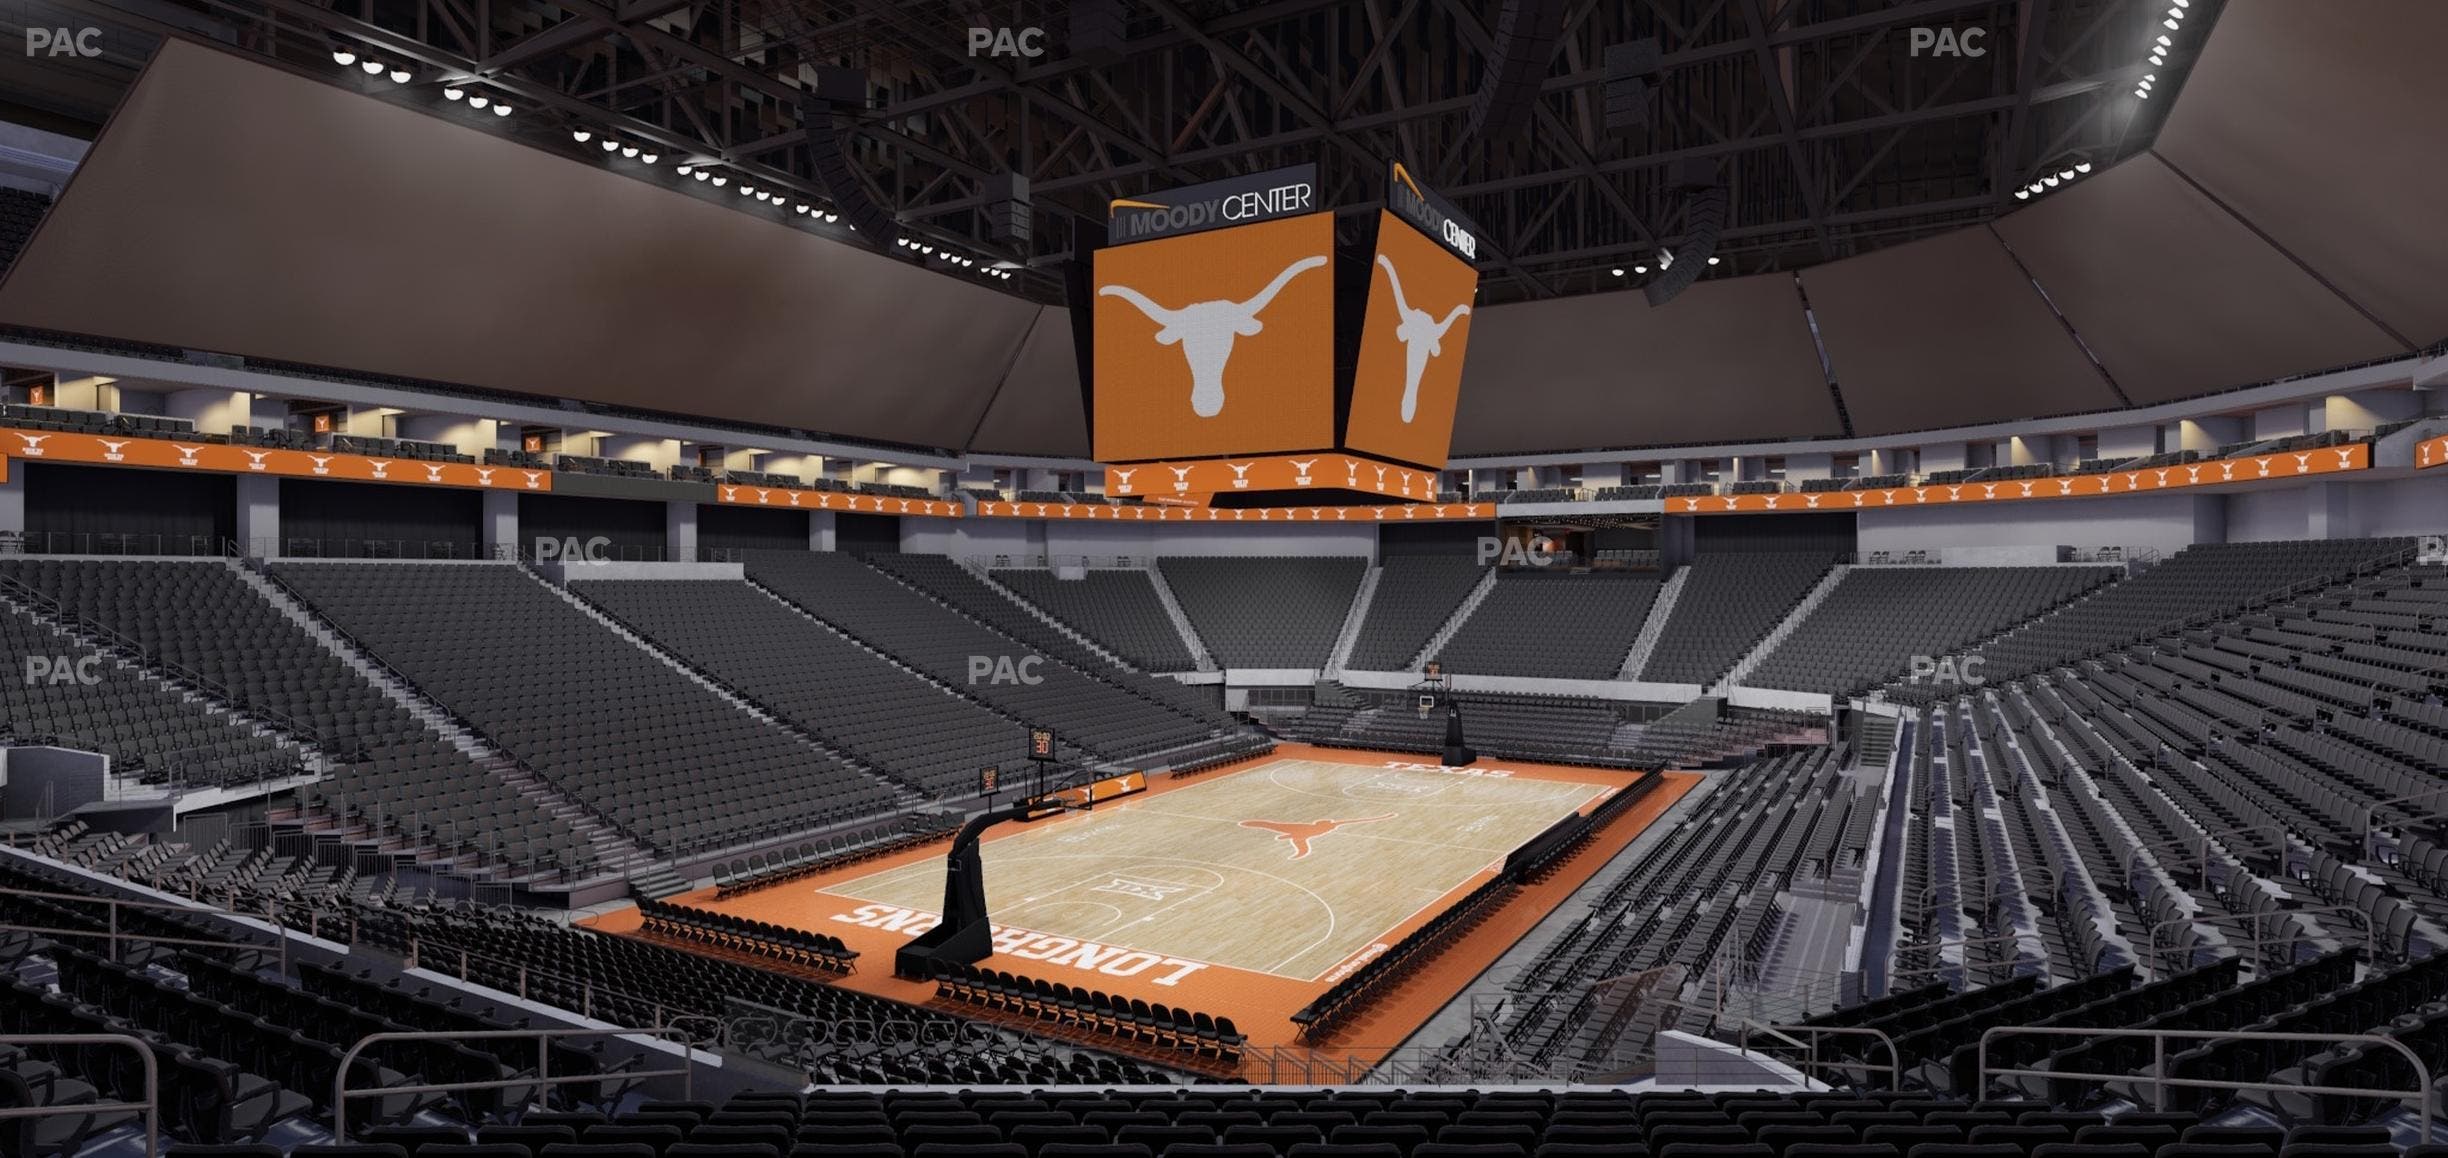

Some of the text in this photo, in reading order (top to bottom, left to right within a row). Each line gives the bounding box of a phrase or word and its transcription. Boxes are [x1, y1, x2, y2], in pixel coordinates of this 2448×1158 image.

[1130, 183, 1311, 237] MOODY CENTER
[1036, 739, 1049, 754] 30
[1383, 760, 1515, 778] TEXAS
